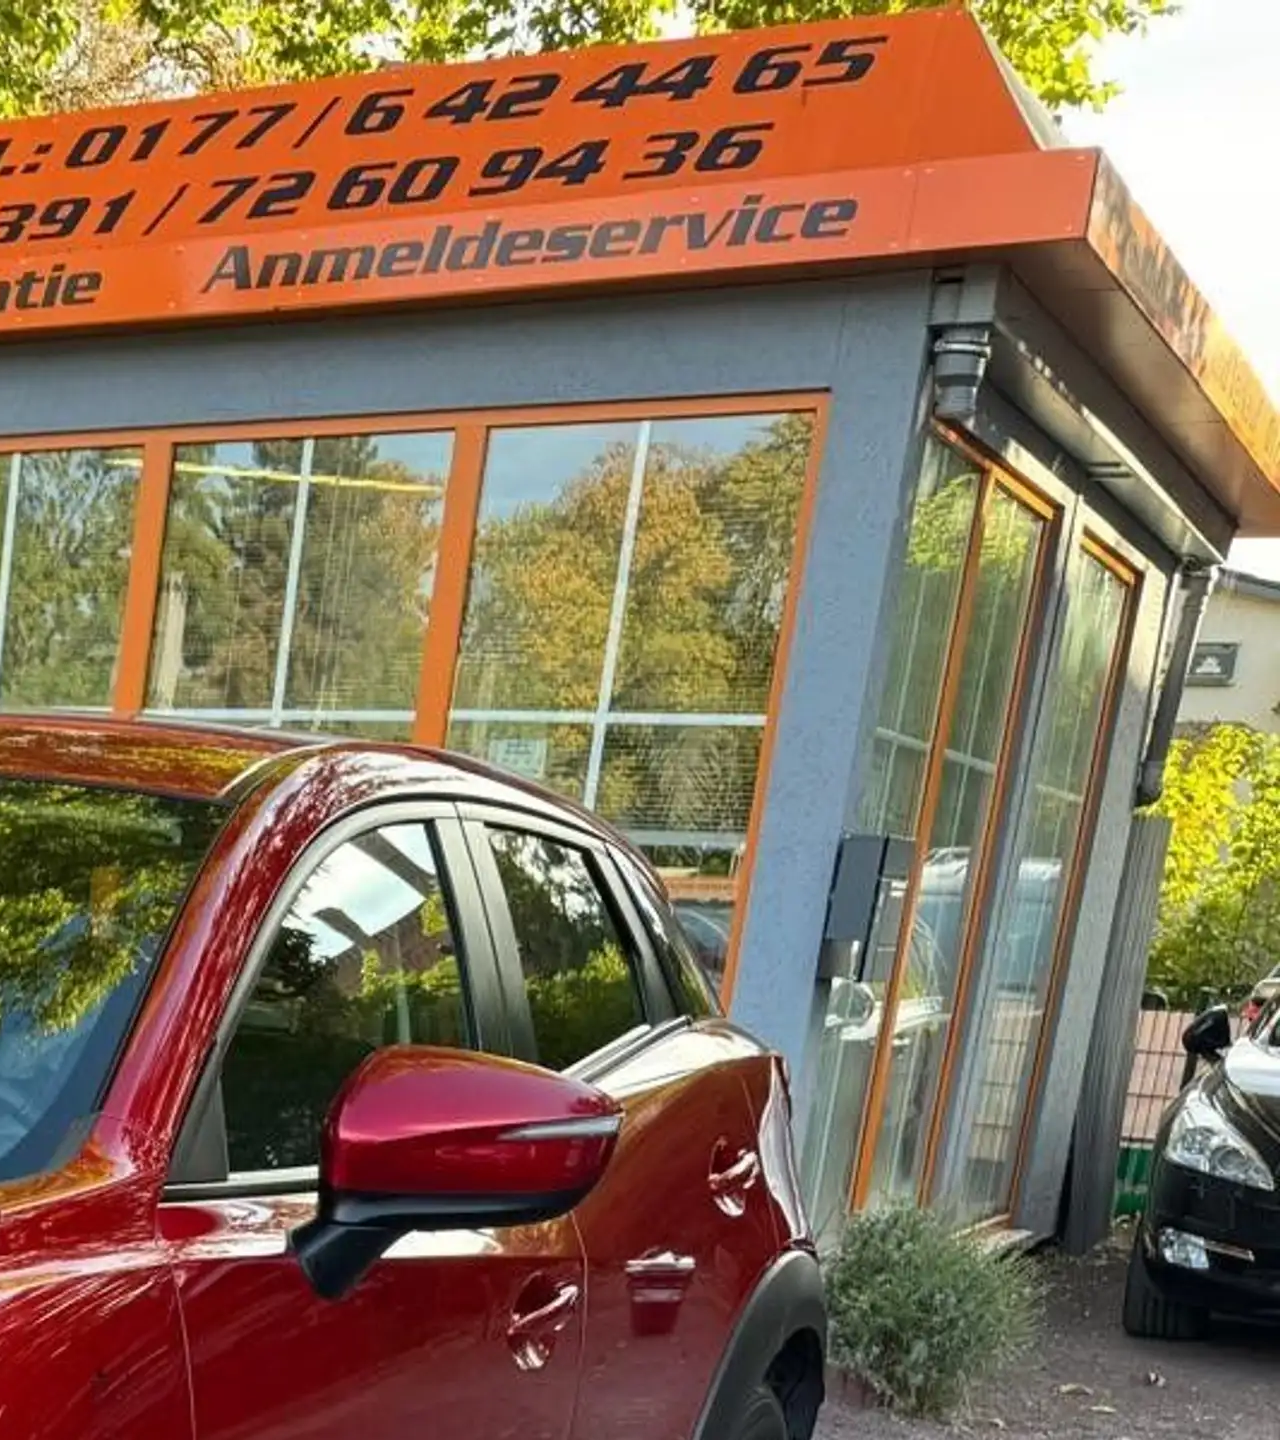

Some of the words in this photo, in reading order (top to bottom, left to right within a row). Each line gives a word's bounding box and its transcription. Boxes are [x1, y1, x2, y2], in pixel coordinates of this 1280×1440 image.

[732, 35, 888, 95] 65
[622, 122, 775, 180] 36
[201, 194, 858, 294] Anmeldeservice
